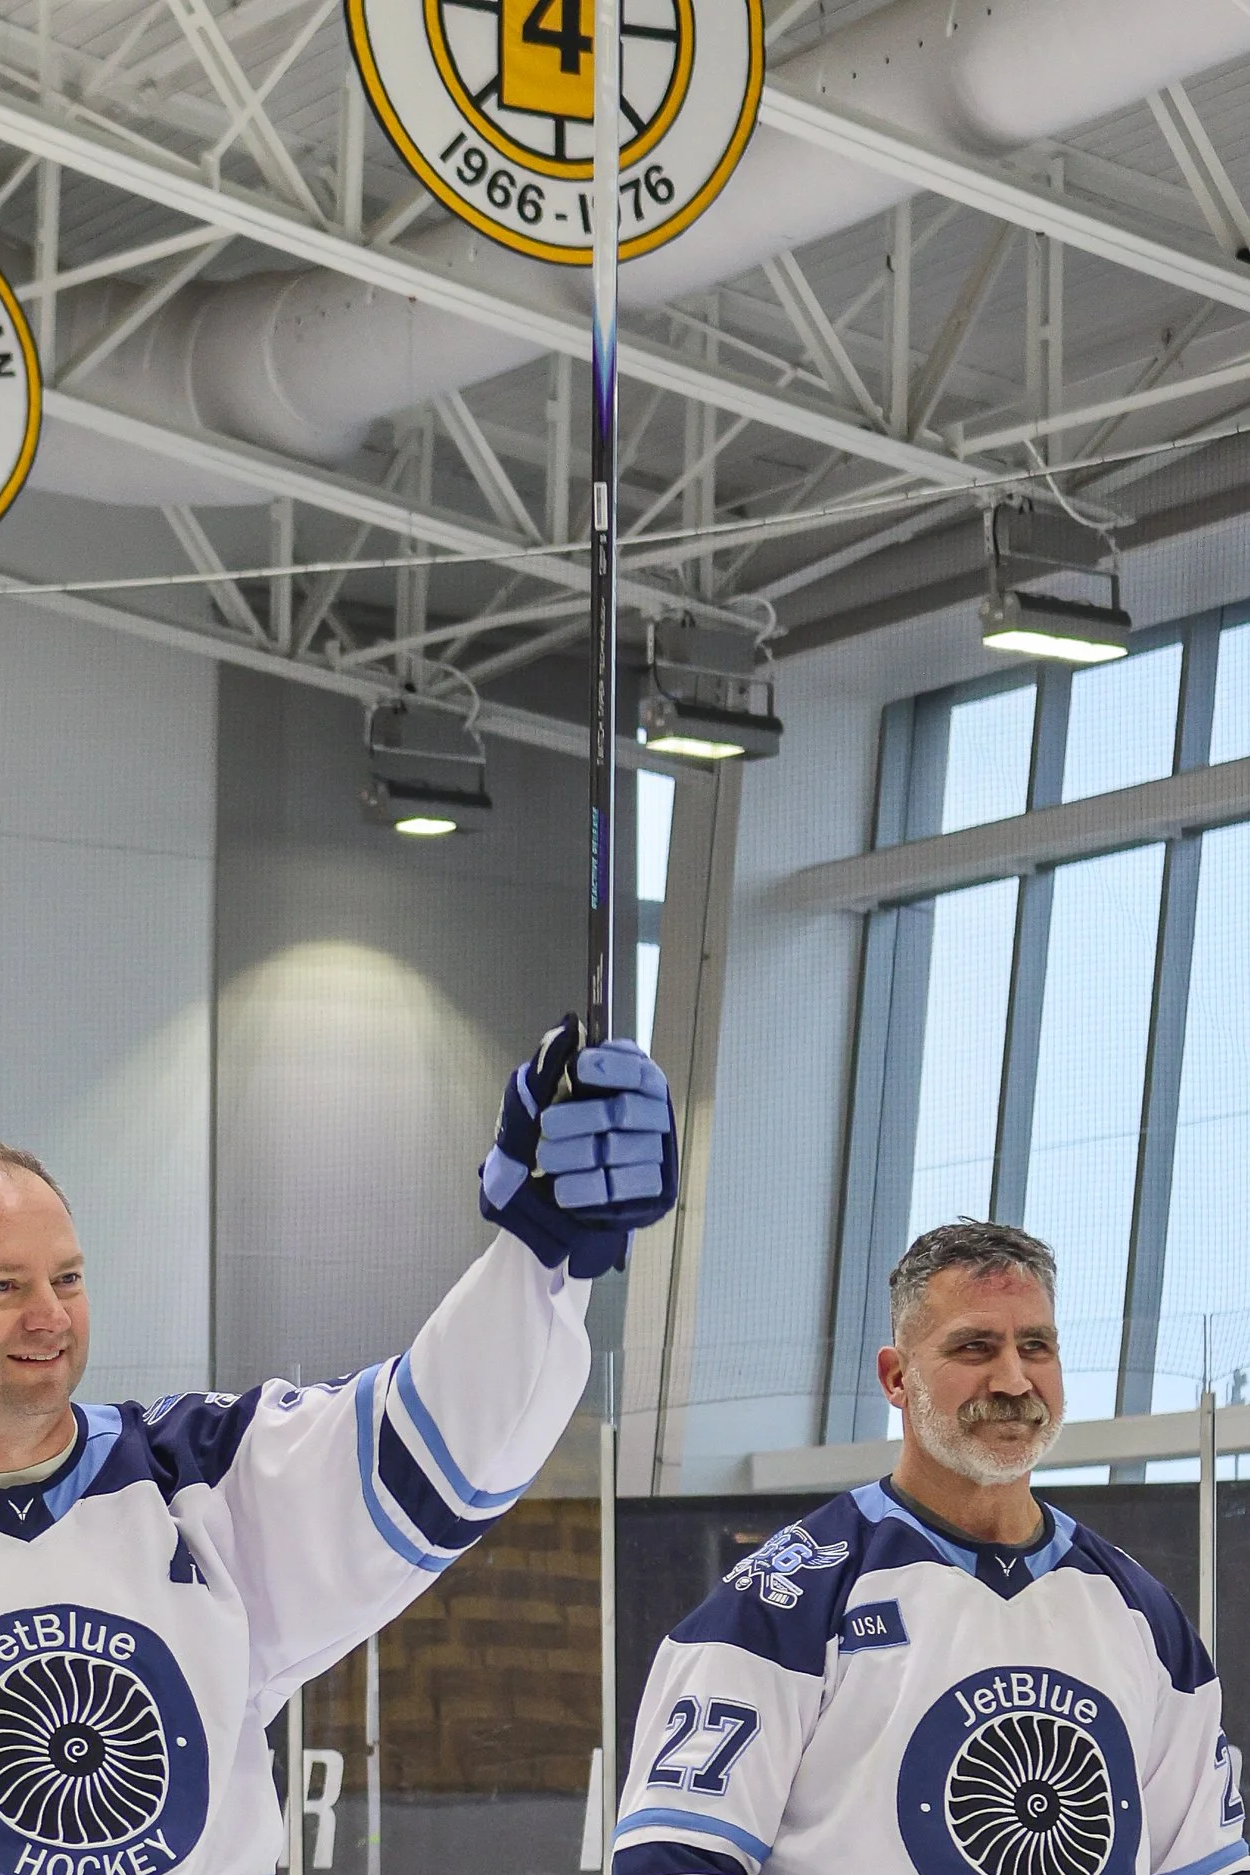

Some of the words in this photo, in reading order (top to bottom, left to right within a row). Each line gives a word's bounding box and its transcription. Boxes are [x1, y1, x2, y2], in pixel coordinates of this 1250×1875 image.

[522, 0, 594, 76] 4
[852, 1615, 888, 1638] USA
[954, 1671, 1099, 1728] JetBlue
[646, 1695, 761, 1796] 27
[1213, 1727, 1246, 1828] 2
